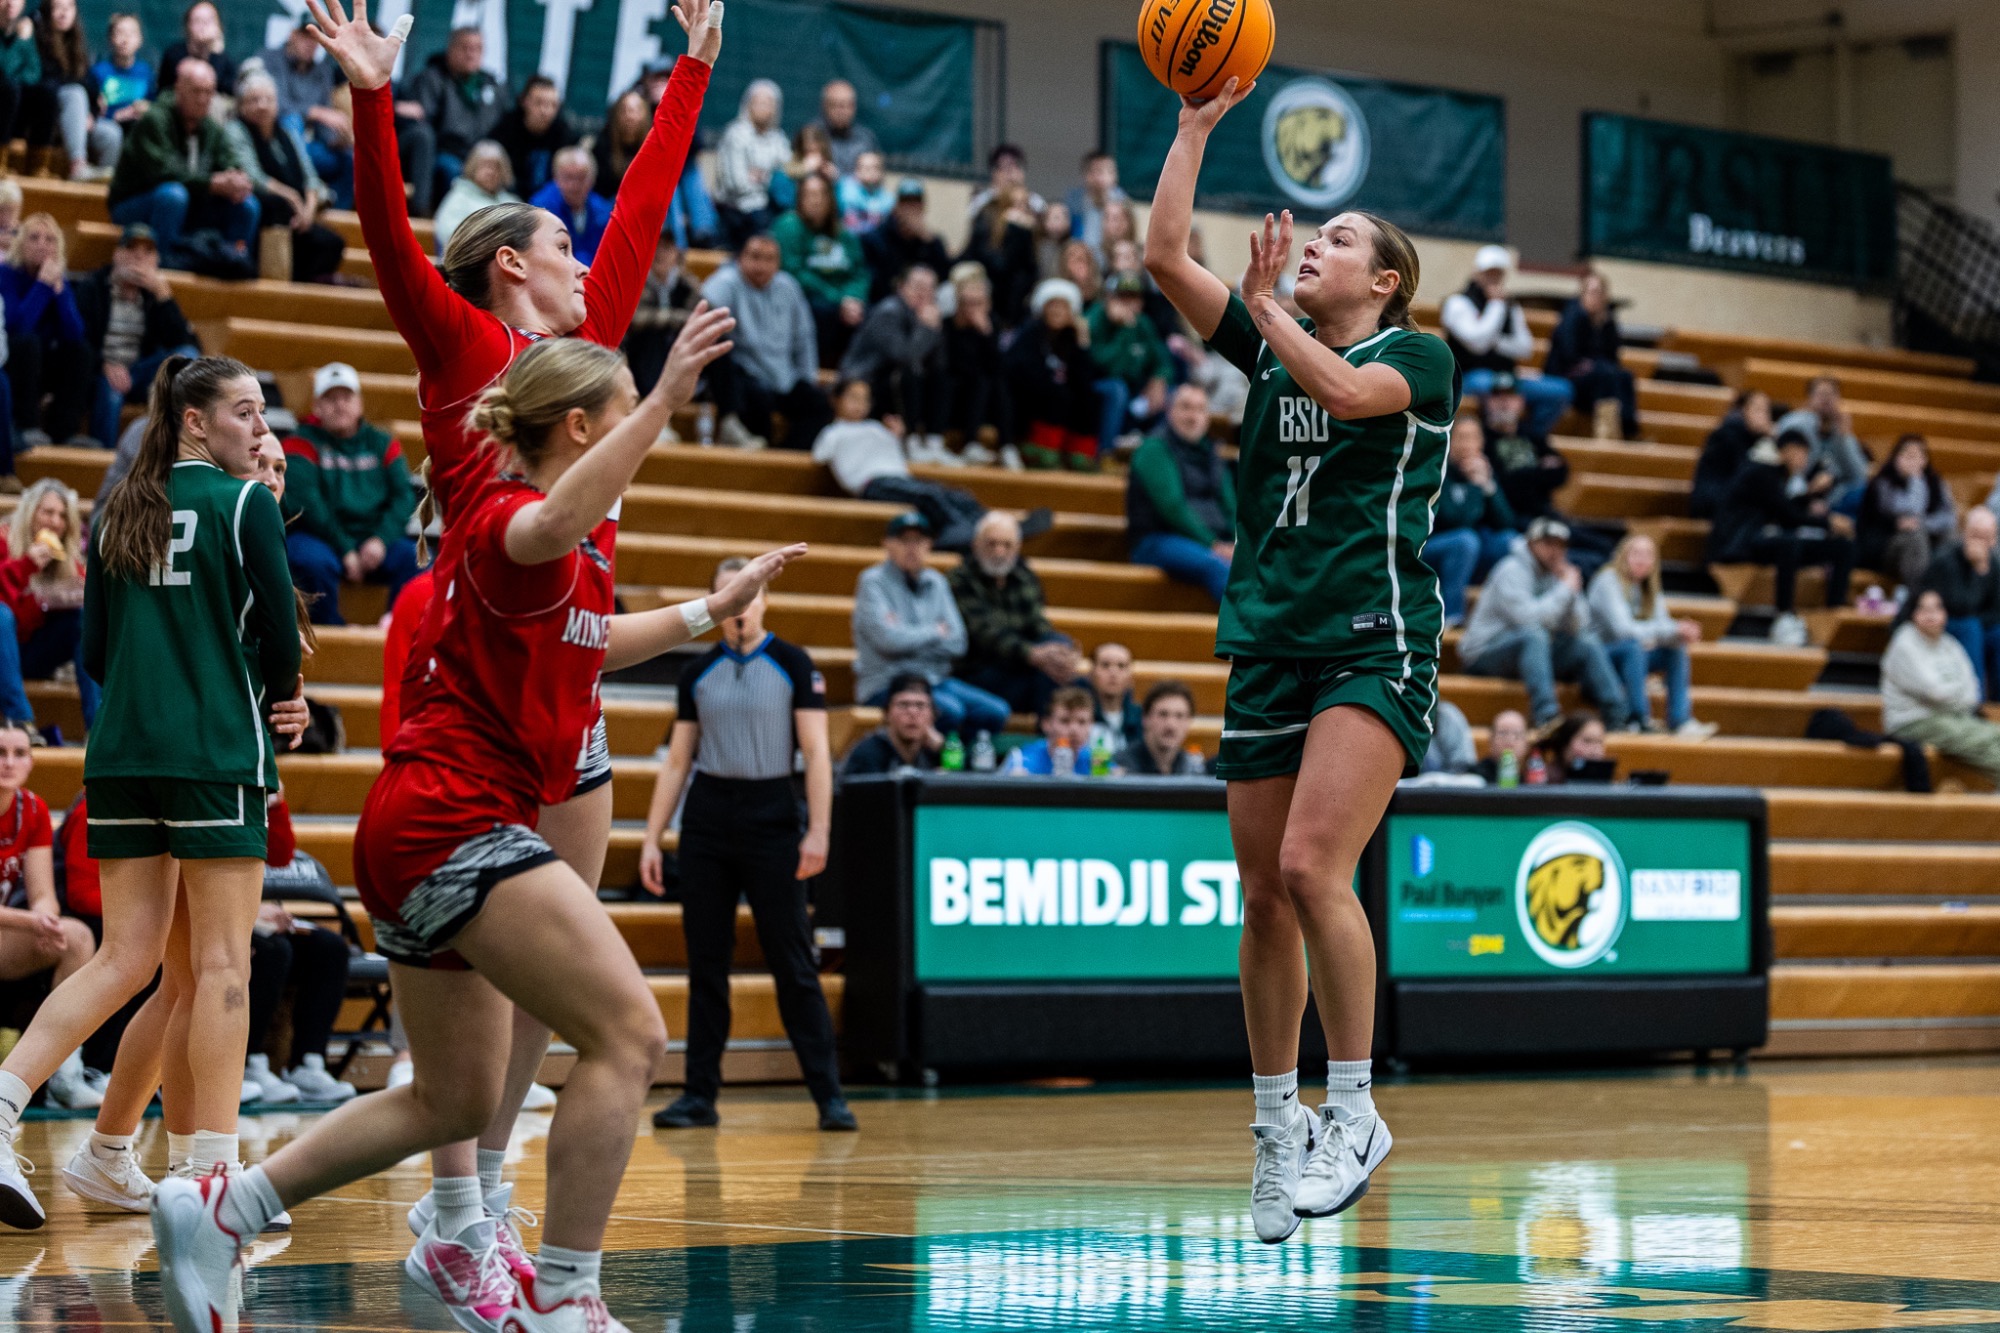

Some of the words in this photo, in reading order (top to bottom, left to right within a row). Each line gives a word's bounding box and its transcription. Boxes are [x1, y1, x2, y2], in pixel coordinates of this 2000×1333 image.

[1178, 0, 1237, 77] Wilson
[1279, 396, 1329, 442] BSU
[1275, 455, 1321, 527] 11
[929, 857, 1170, 927] BEMIDJI
[1179, 859, 1245, 927] ST
